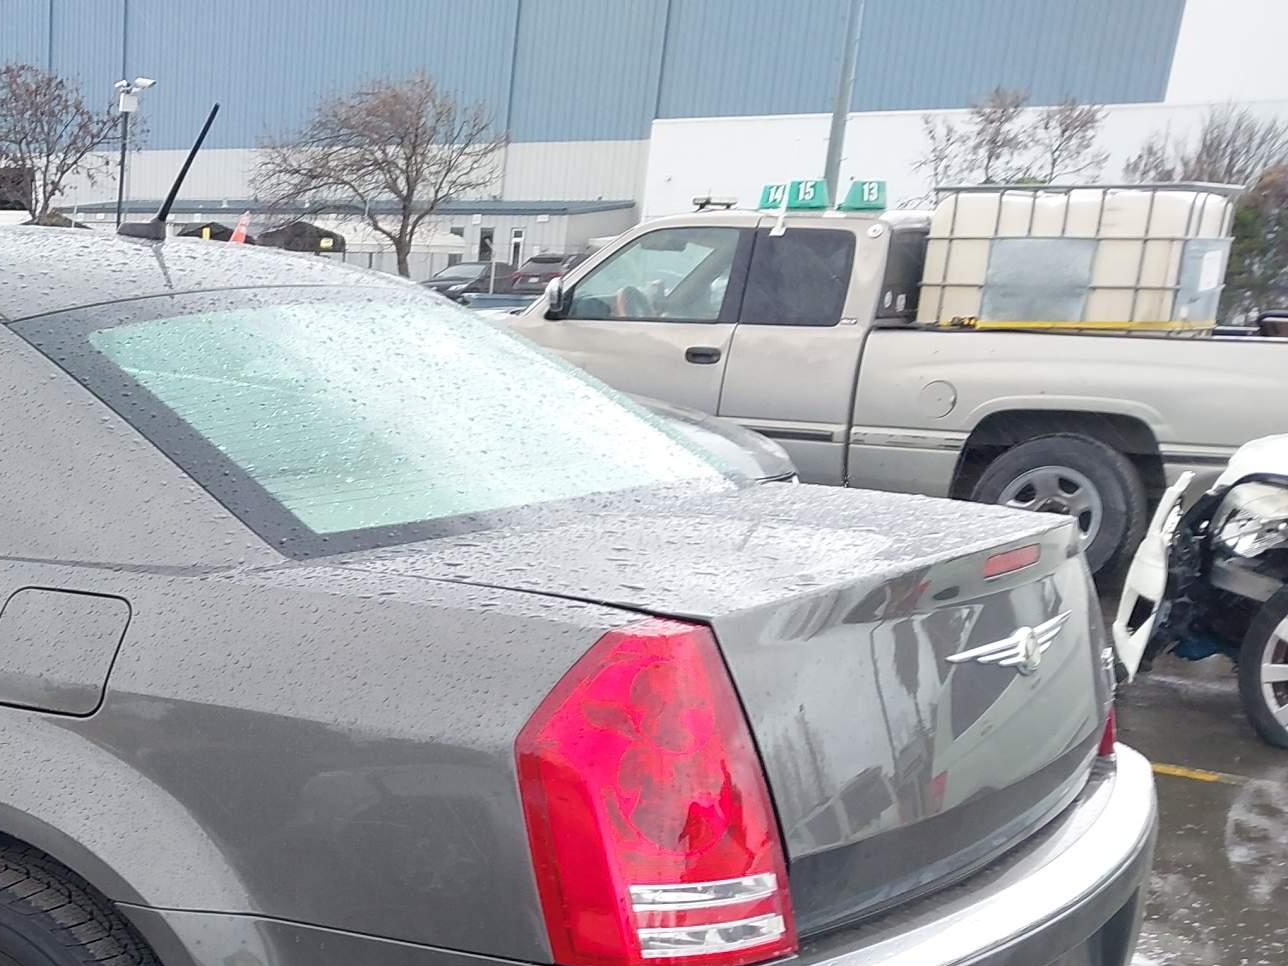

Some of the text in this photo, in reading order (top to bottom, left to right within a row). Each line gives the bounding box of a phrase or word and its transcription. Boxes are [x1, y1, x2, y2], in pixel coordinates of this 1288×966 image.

[768, 185, 785, 204] 14
[798, 181, 815, 201] 15
[862, 182, 879, 202] 13
